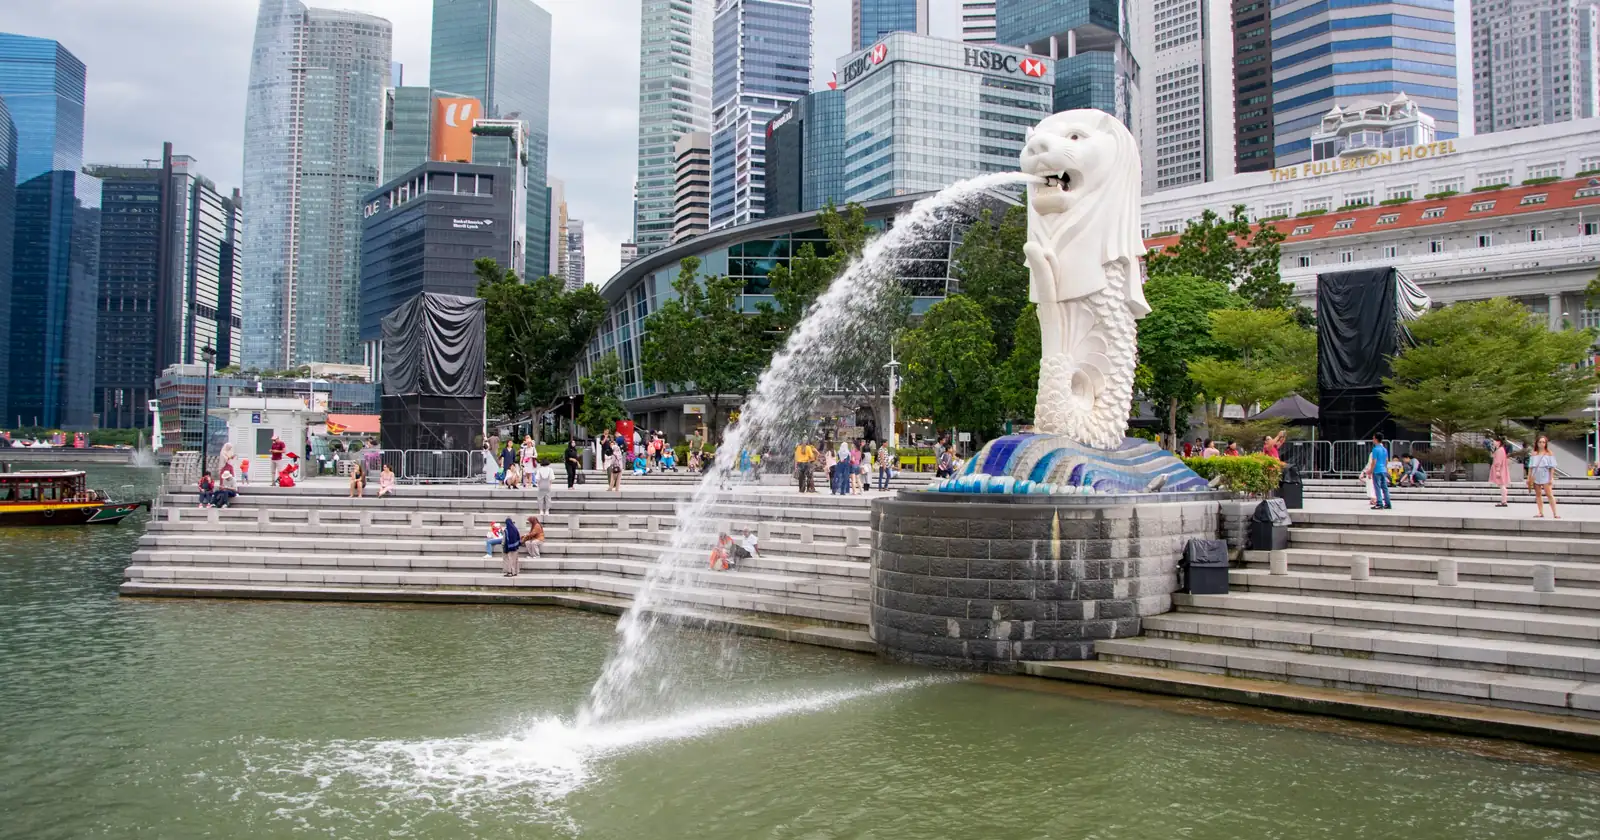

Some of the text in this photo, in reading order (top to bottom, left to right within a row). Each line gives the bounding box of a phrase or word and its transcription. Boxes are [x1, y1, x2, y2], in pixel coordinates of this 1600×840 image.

[844, 51, 871, 84] HSBC
[964, 47, 1018, 73] HSBC
[1269, 139, 1457, 182] THE FULLERTON HOTEL
[364, 200, 380, 218] OUE
